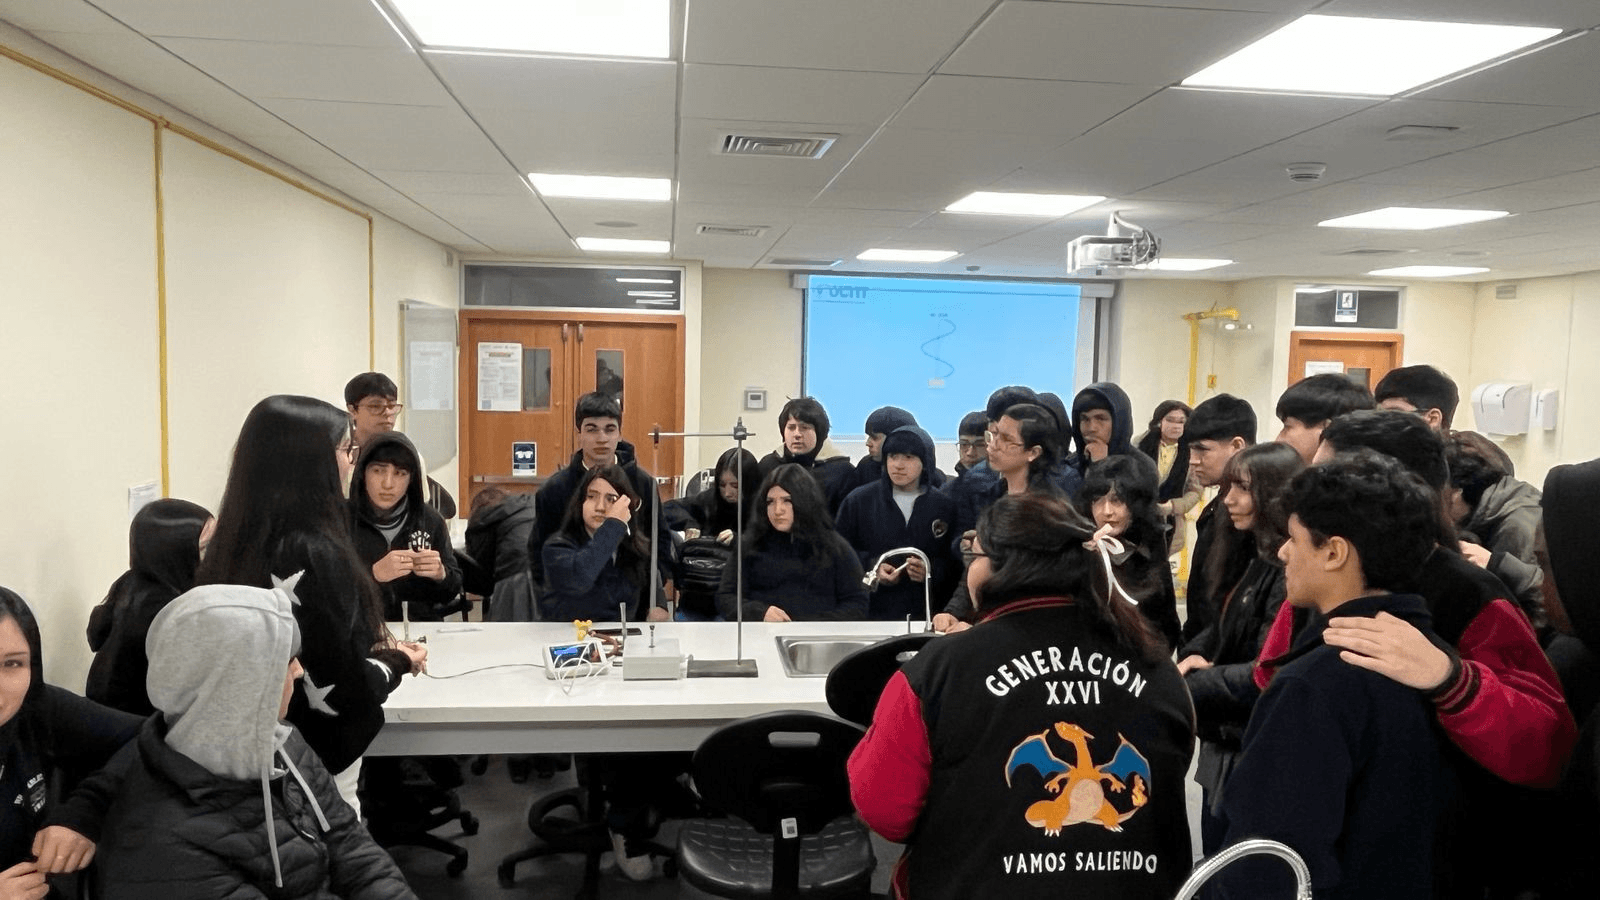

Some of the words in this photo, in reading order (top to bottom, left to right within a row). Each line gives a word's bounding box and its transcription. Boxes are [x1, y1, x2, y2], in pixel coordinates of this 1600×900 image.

[985, 646, 1147, 698] GENERACIÓN
[1045, 681, 1100, 705] XXVI
[1003, 852, 1066, 874] VAMOS
[1075, 851, 1158, 874] SALIENDO
